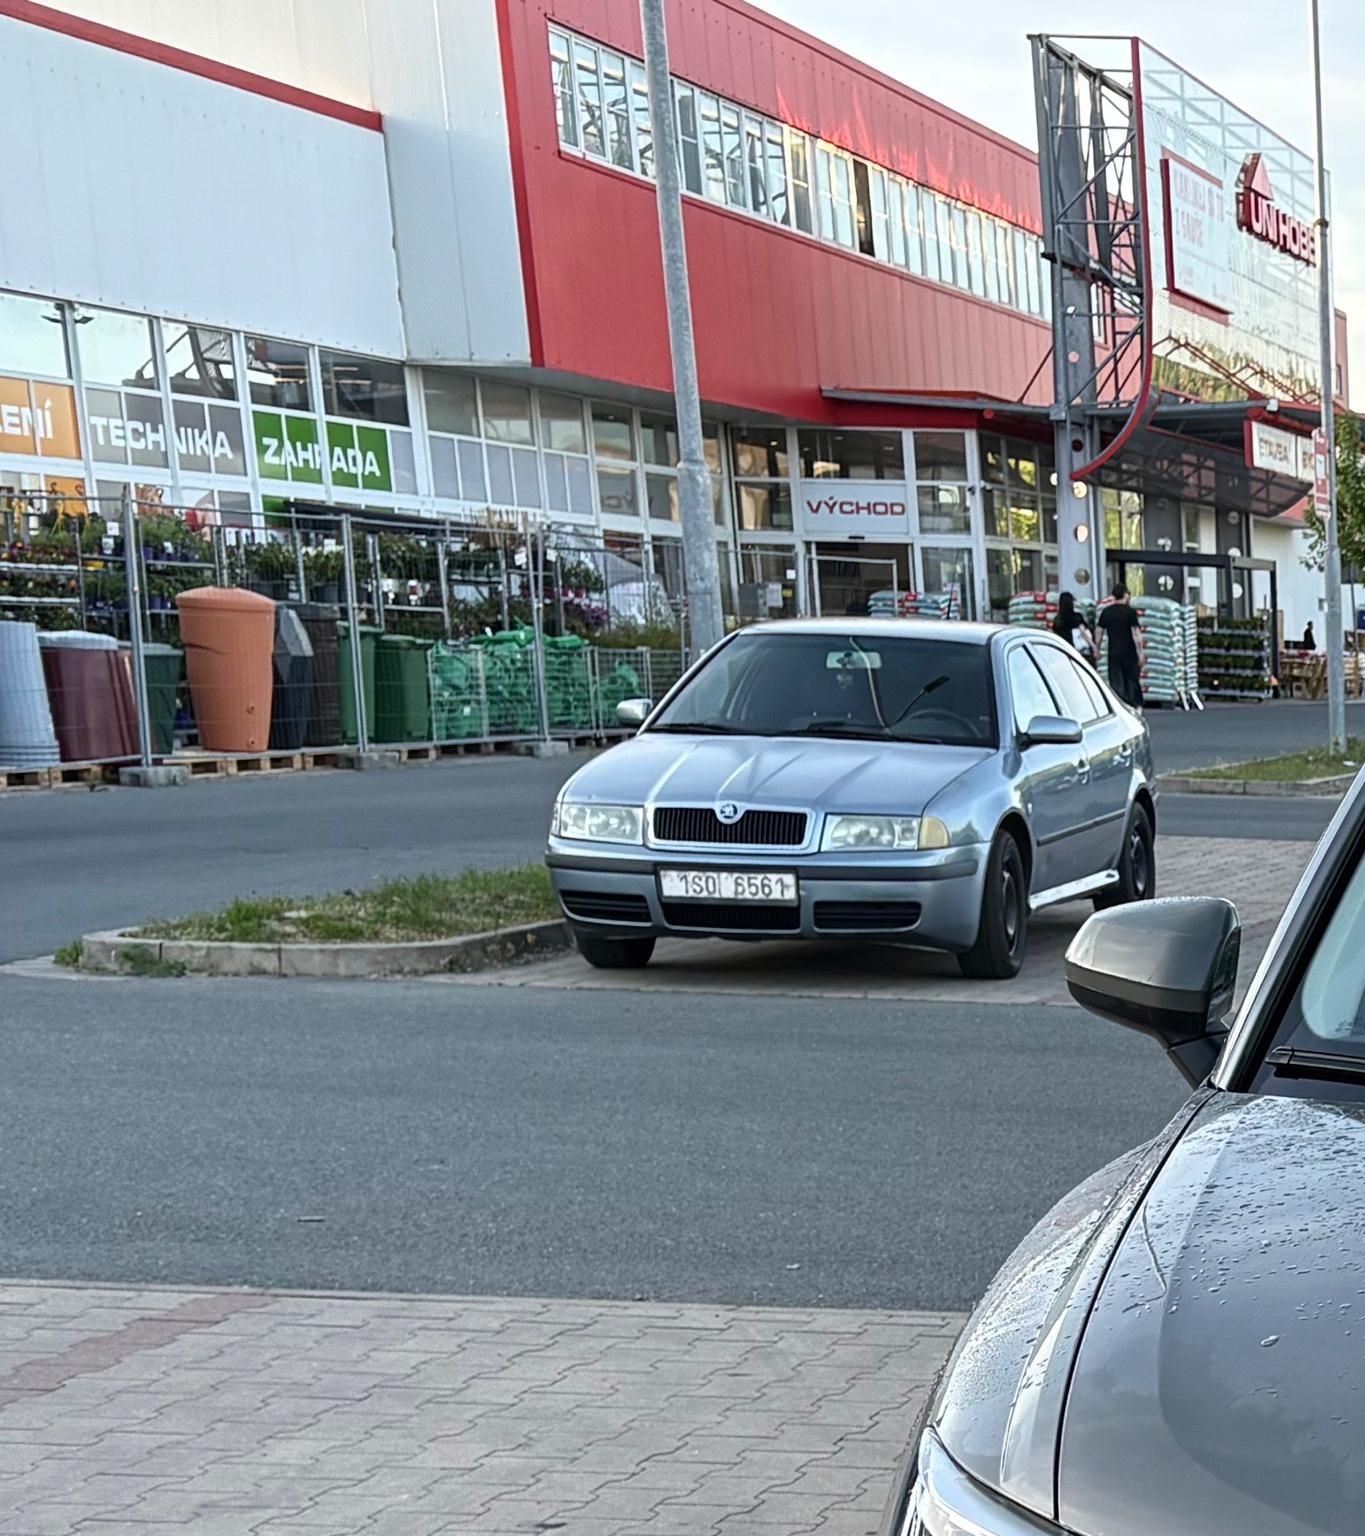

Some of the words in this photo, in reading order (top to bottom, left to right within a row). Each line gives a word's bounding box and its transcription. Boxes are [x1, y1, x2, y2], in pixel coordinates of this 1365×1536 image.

[1250, 191, 1278, 244] UNI
[1278, 210, 1318, 264] HOBB
[0, 397, 54, 440] ENÍ
[89, 415, 234, 460] TECHNIKA
[806, 496, 907, 517] VÝCHOD
